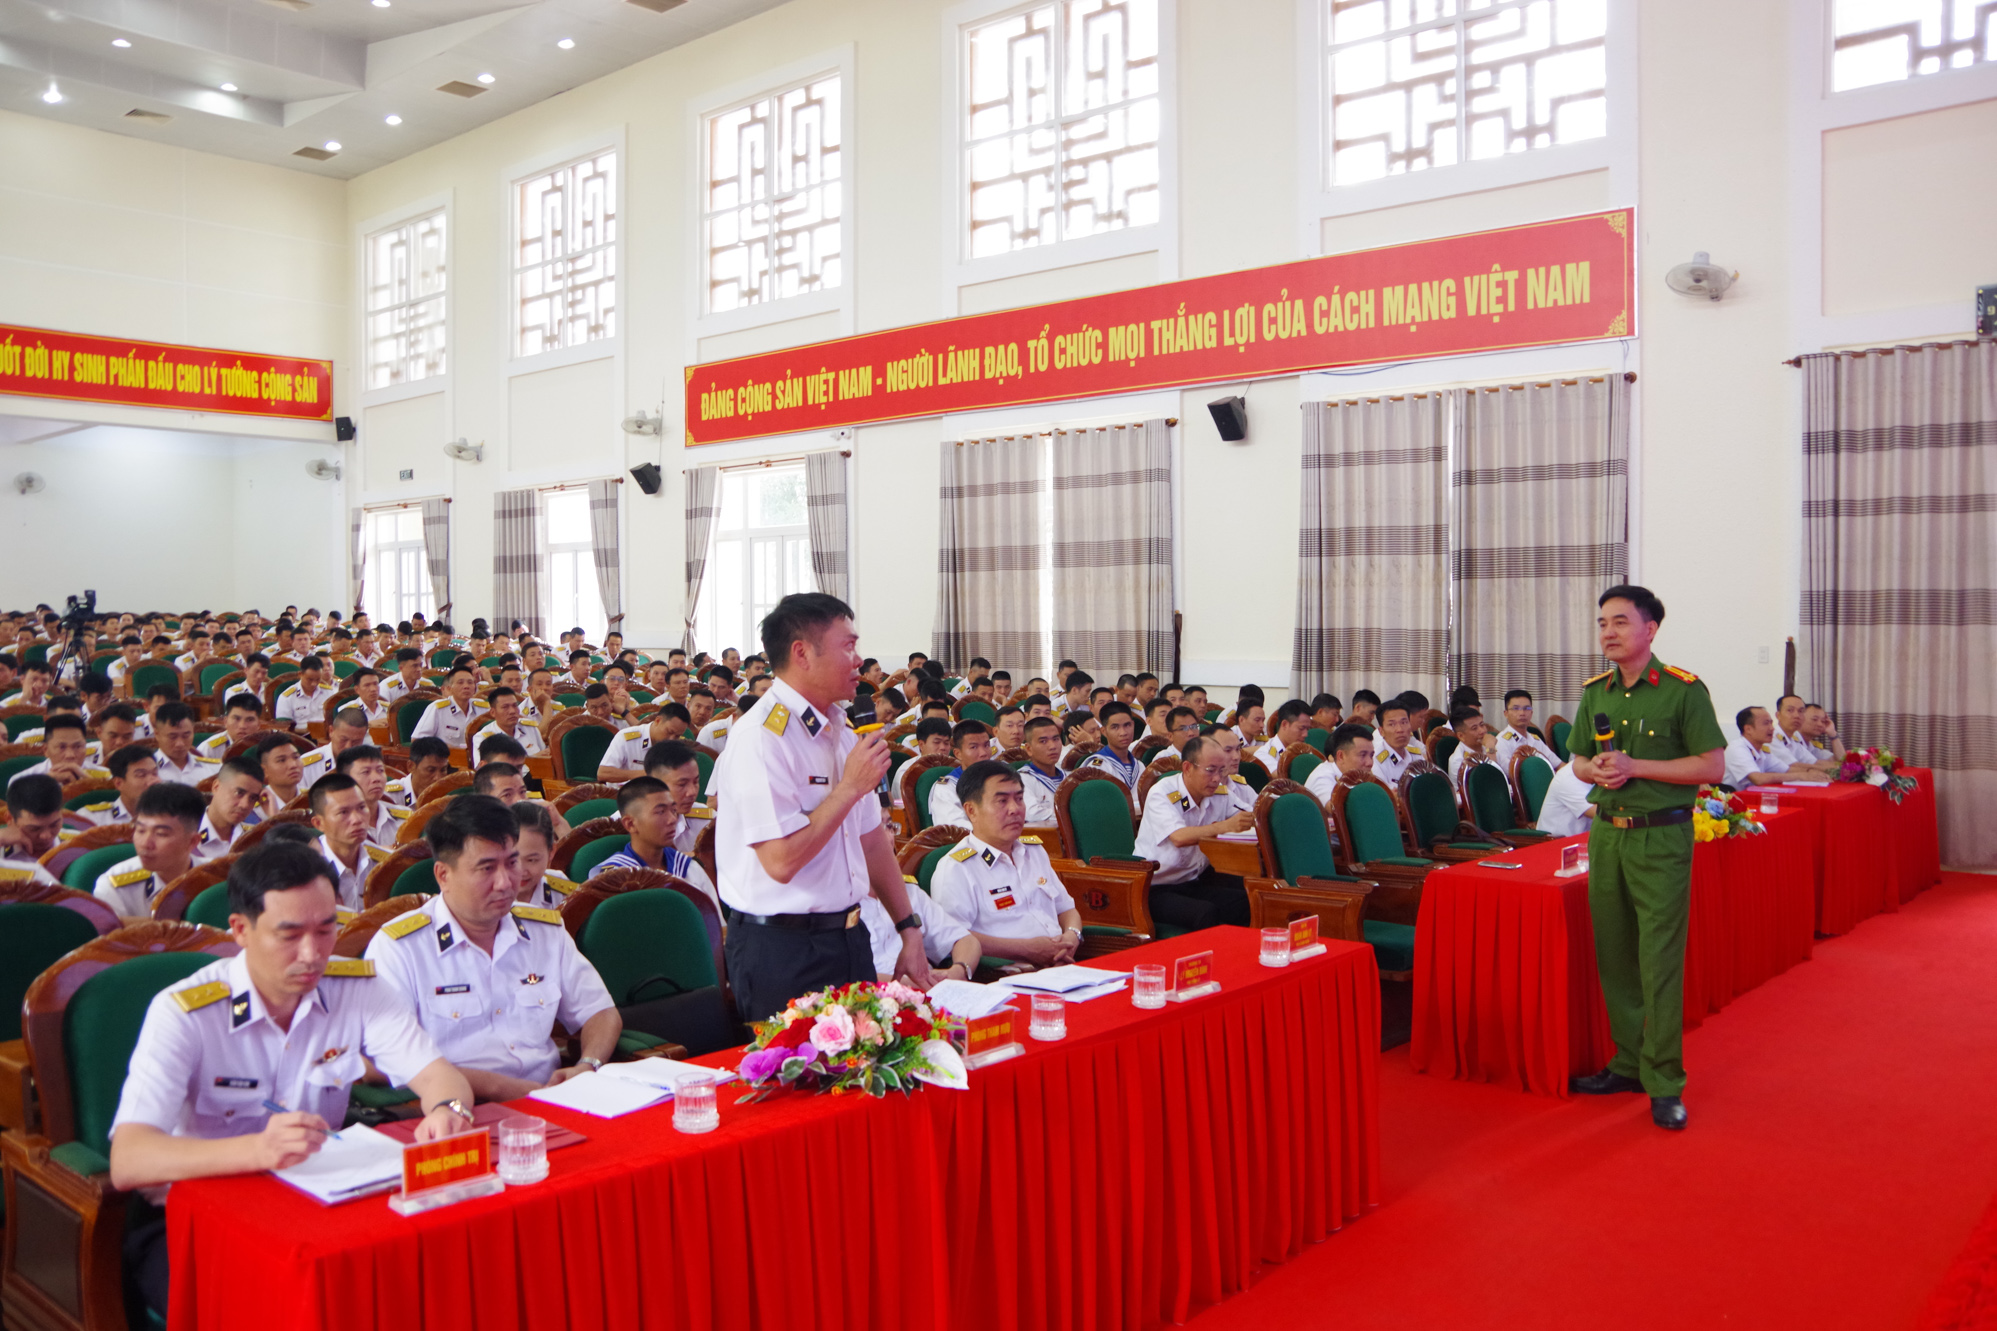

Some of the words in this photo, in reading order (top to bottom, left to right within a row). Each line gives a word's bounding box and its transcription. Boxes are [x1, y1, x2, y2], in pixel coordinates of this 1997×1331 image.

[24, 340, 50, 379] ĐỜI
[52, 350, 71, 381] HY
[73, 352, 107, 385] SINH
[109, 348, 146, 389] PHẤN
[147, 351, 174, 391] ĐẤU
[176, 363, 202, 394] CHO
[203, 361, 218, 395] LÝ
[220, 360, 259, 399] TƯỞNG
[261, 367, 293, 407] CỘNG
[295, 367, 318, 404] SẢN
[701, 381, 735, 421] ĐẢNG
[737, 379, 772, 421] CỘNG
[775, 369, 803, 411] SẢN
[806, 367, 836, 410] VIỆT
[838, 365, 872, 400] NAM
[886, 348, 933, 392] NGƯỜI
[938, 345, 980, 385] LÃNH
[984, 342, 1022, 385] ĐẠO,
[1027, 324, 1050, 373] TỔ
[1054, 326, 1103, 370] CHỨC
[1108, 326, 1146, 367] MỌI
[1151, 303, 1217, 355] THẮNG
[1223, 303, 1256, 352] LỢI
[1262, 288, 1307, 342] CỦA
[1313, 286, 1375, 335] CÁCH
[1383, 279, 1456, 332] MẠNG
[1464, 264, 1519, 323] VIỆT
[1527, 261, 1591, 310] NAM
[1091, 891, 1103, 907] B
